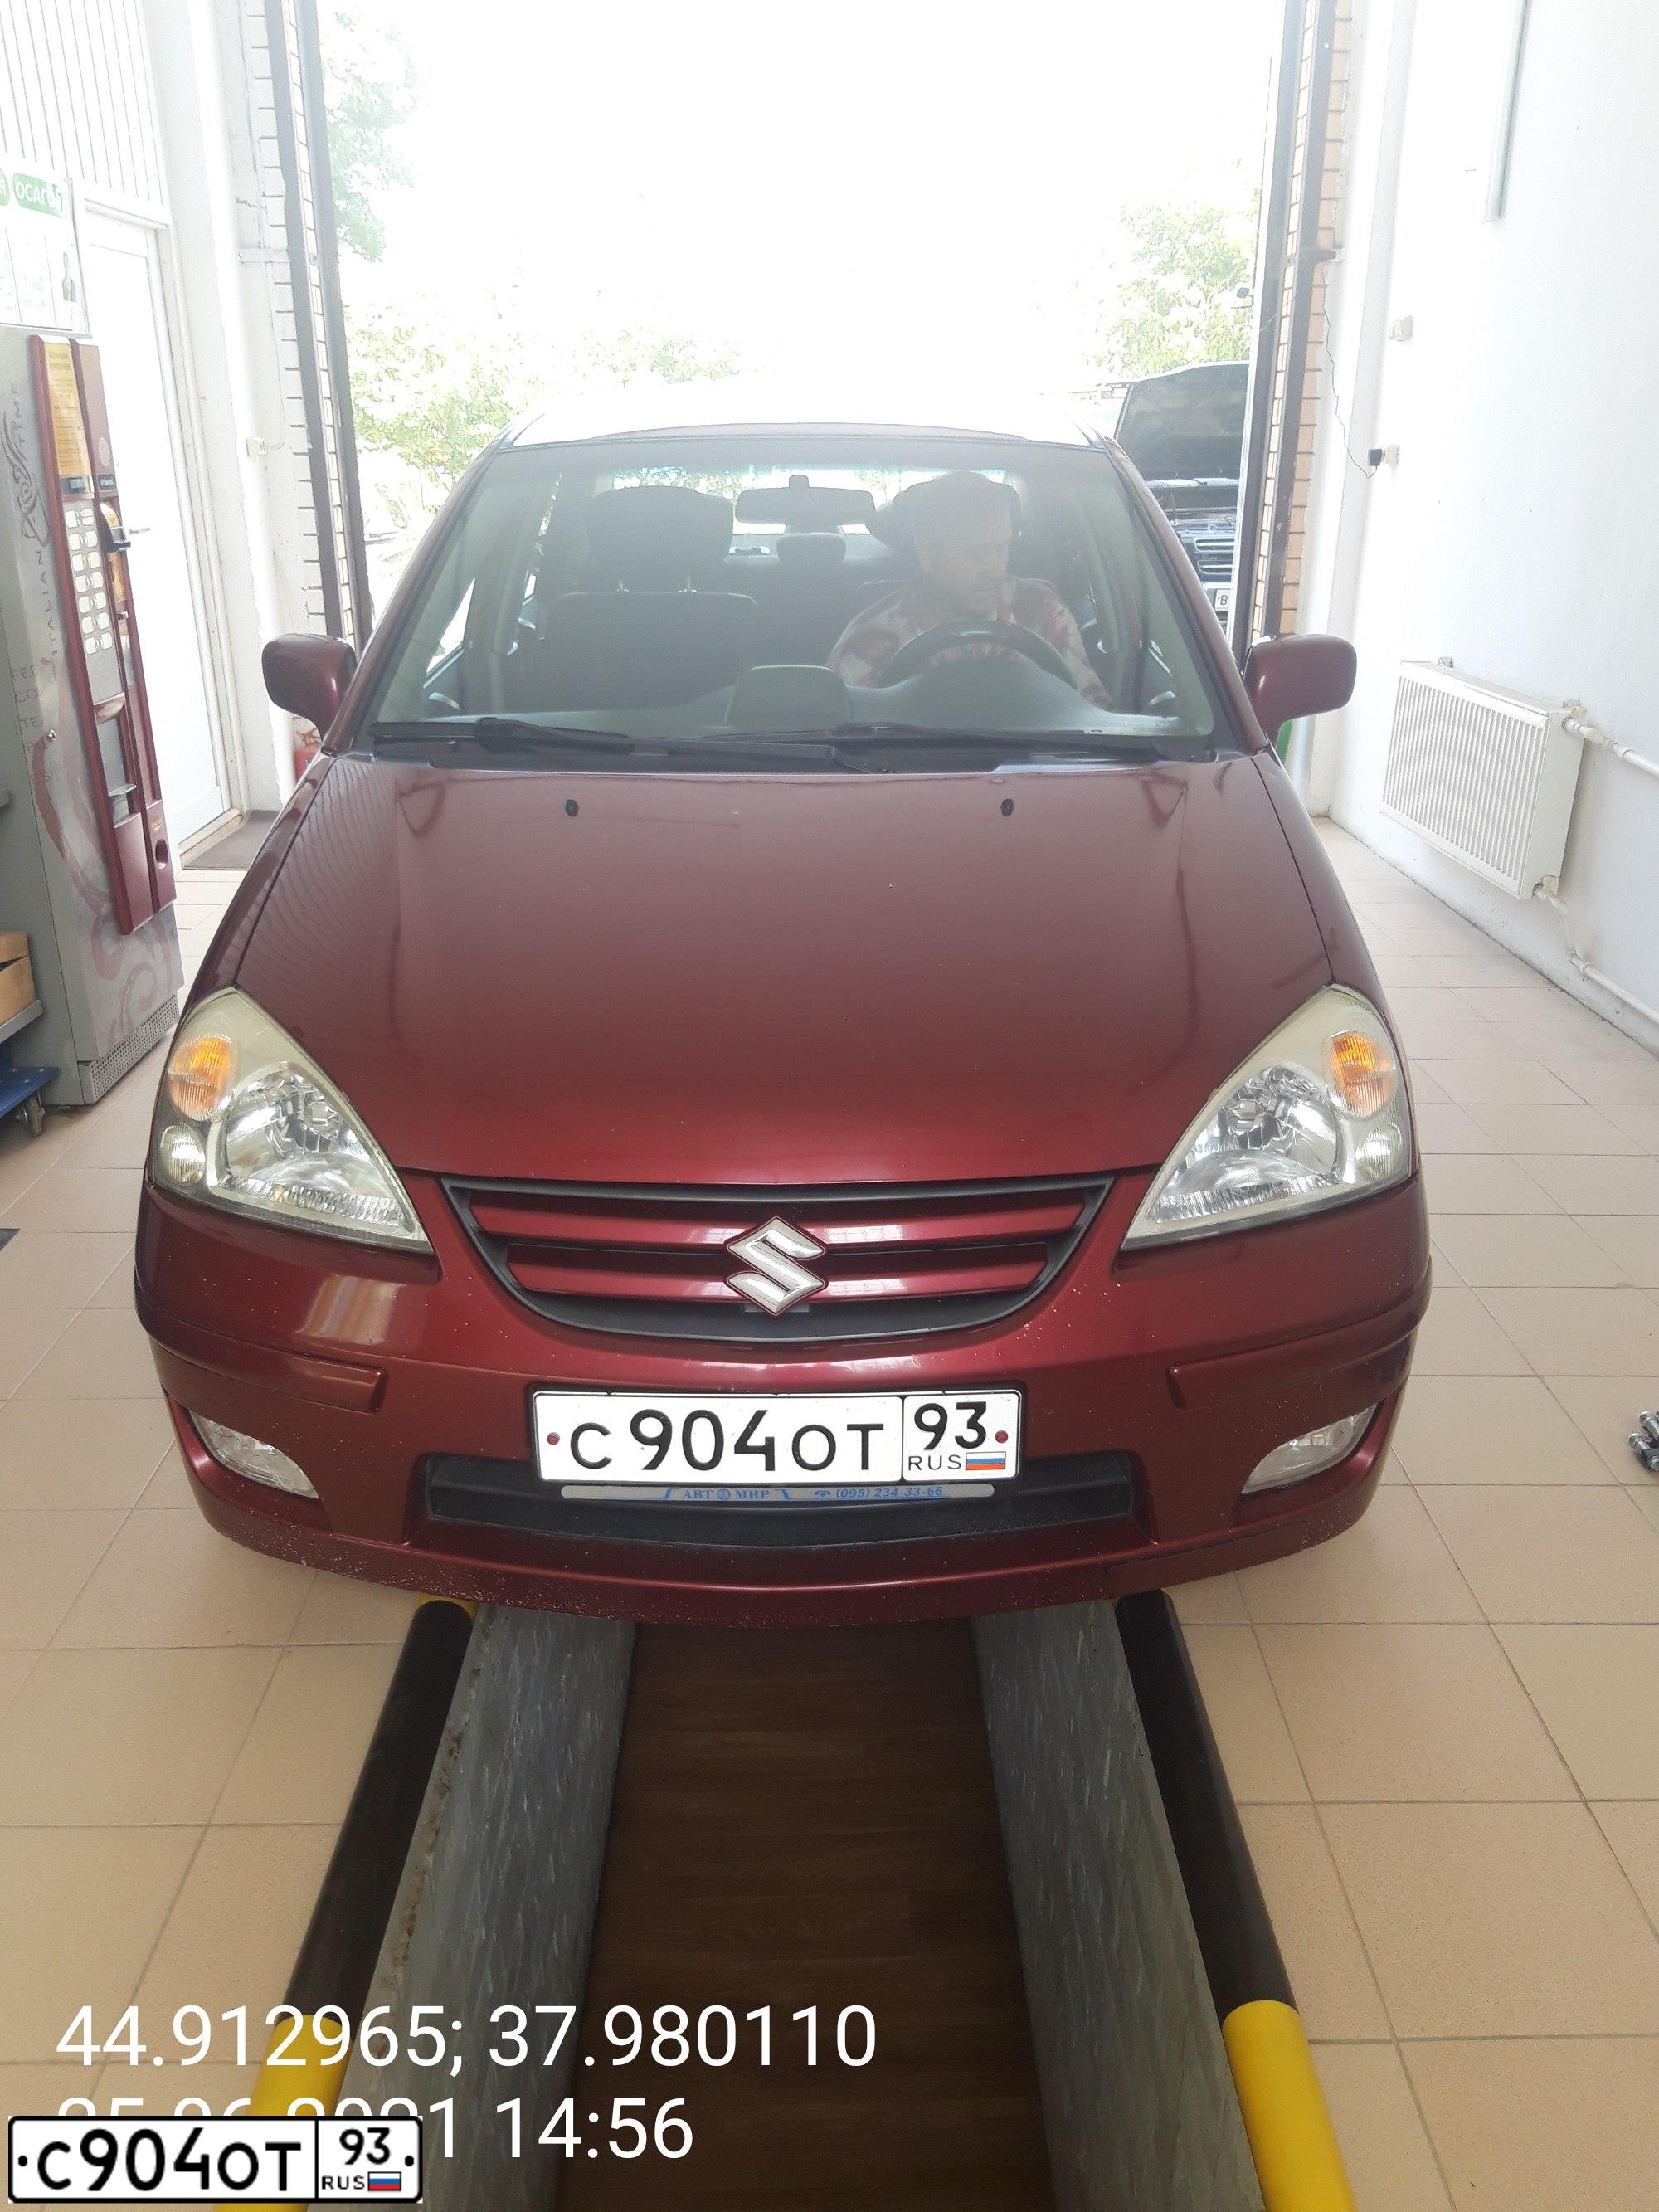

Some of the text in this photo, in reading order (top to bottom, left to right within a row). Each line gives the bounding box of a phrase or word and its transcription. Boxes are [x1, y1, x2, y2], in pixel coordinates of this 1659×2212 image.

[36, 550, 58, 655] ITALIAN
[570, 1401, 987, 1471] С904ОТ 93
[908, 1454, 962, 1471] RUS
[836, 1487, 870, 1498] (095)
[874, 1486, 943, 1498] 234-33-66
